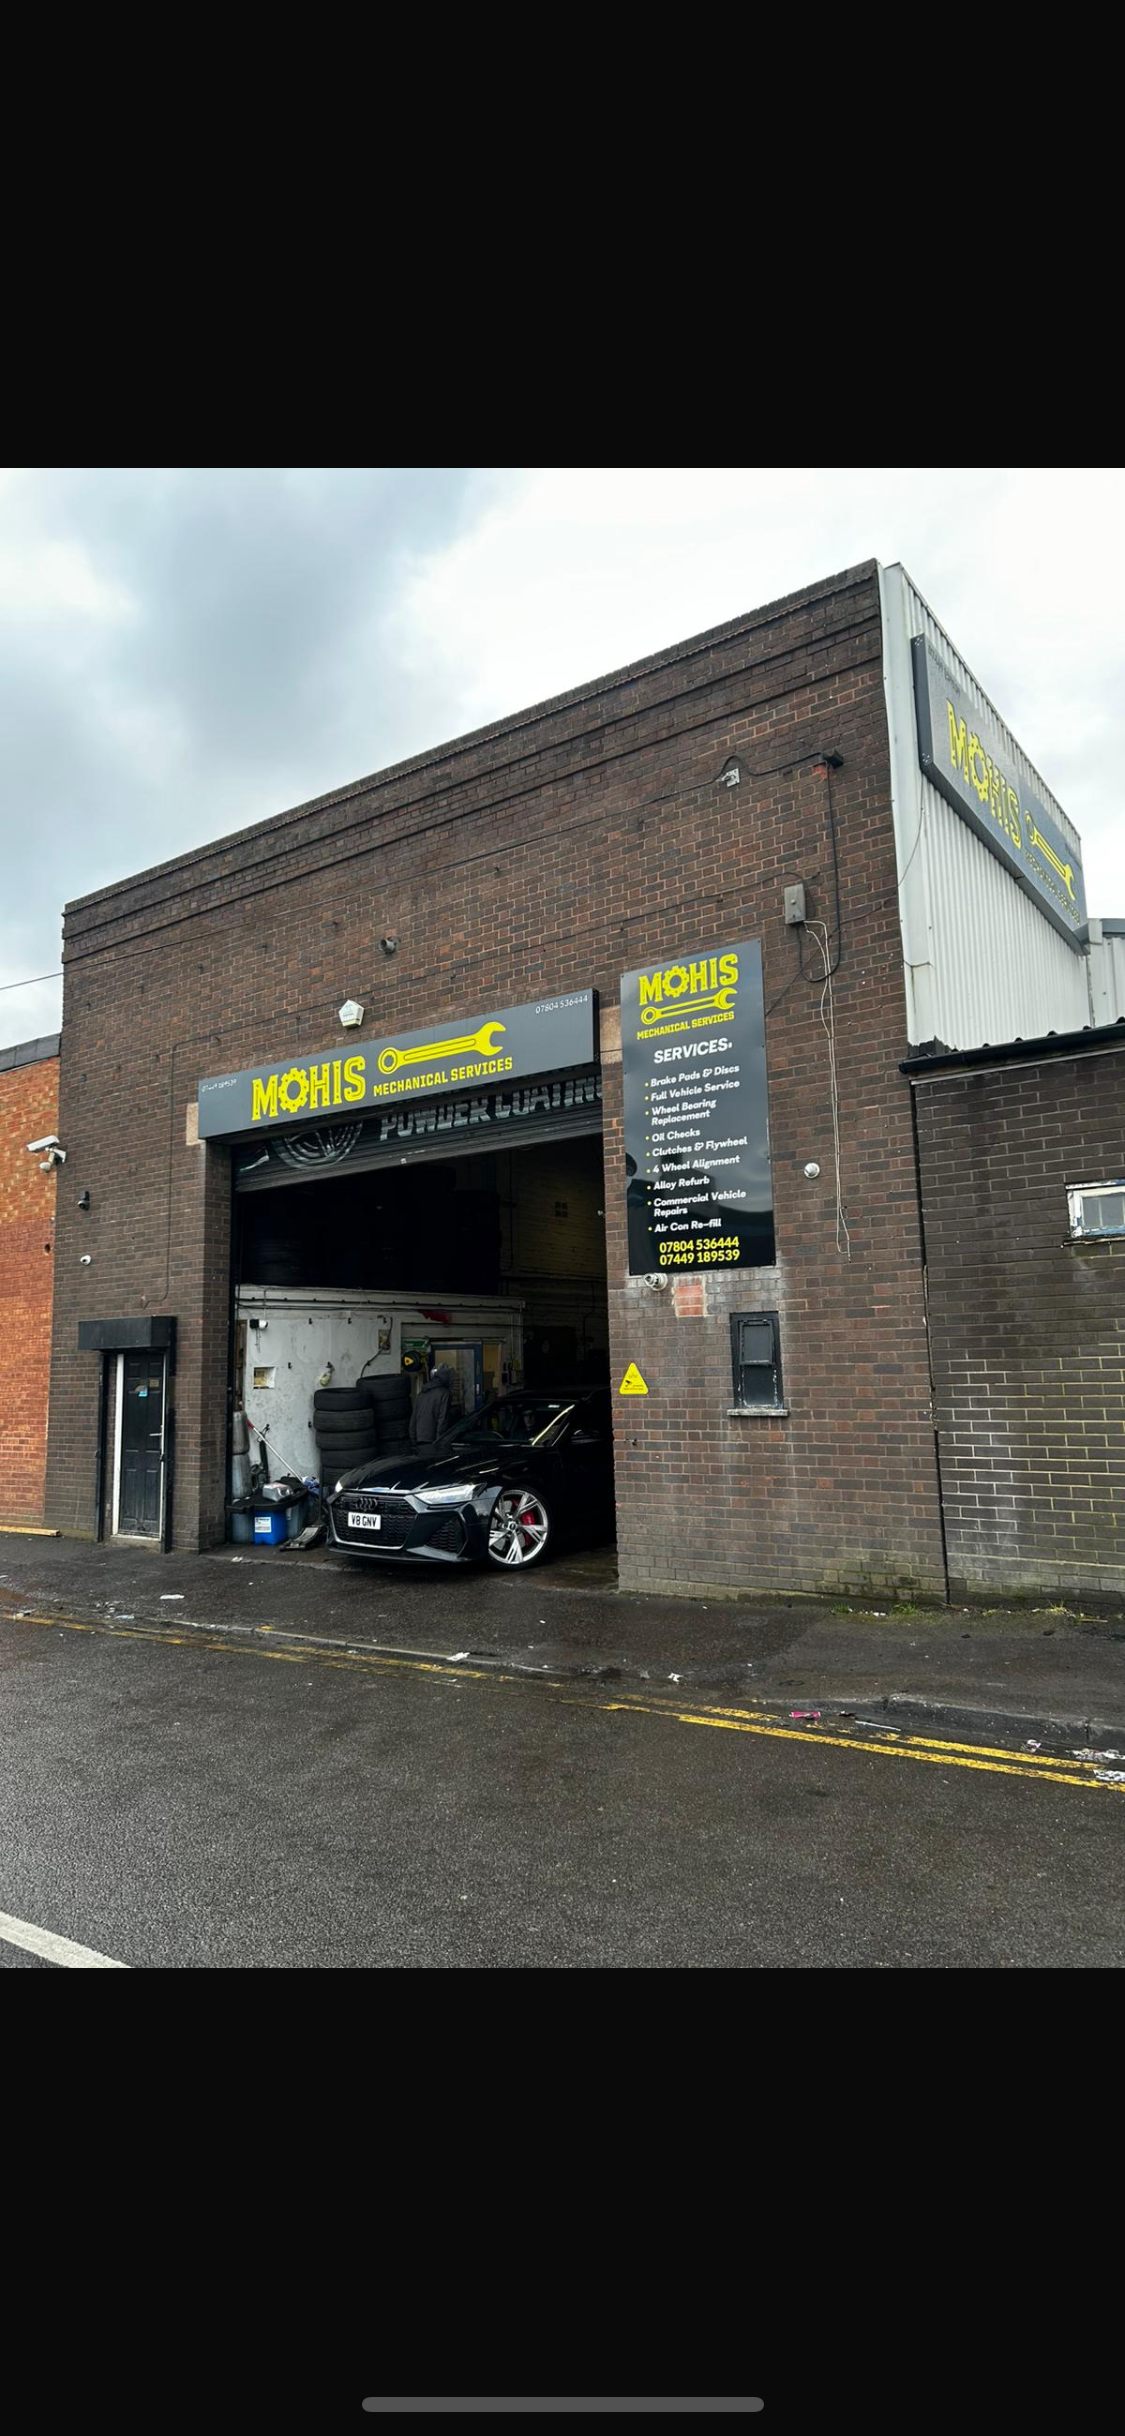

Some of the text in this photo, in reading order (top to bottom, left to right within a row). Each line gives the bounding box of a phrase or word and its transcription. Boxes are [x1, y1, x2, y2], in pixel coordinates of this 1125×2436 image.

[947, 698, 1021, 849] MOHIS
[639, 953, 739, 1005] MOHIS
[637, 1011, 735, 1039] MECHANICAL SERVICES
[373, 1057, 513, 1097] MECHANICAL SERVICES
[650, 1065, 740, 1087] Brake Pads & Discs
[252, 1056, 366, 1120] MOHIS
[650, 1080, 740, 1102] Full Vehicle Service
[651, 1099, 717, 1116] Wheel Bearing
[651, 1109, 711, 1126] Replacement
[651, 1128, 701, 1142] Oil Checks
[652, 1136, 748, 1157] Clutches & Flywheel
[652, 1154, 741, 1173] 4 Wheel Alignment
[653, 1175, 710, 1191] Alloy Refurb
[653, 1189, 747, 1207] Commercial Vehicle
[653, 1206, 688, 1218] Repairs
[654, 1218, 722, 1233] Air Con Re-fill
[659, 1236, 740, 1253] 07804 536444
[659, 1248, 740, 1266] 07449 189539
[351, 1514, 361, 1526] V8
